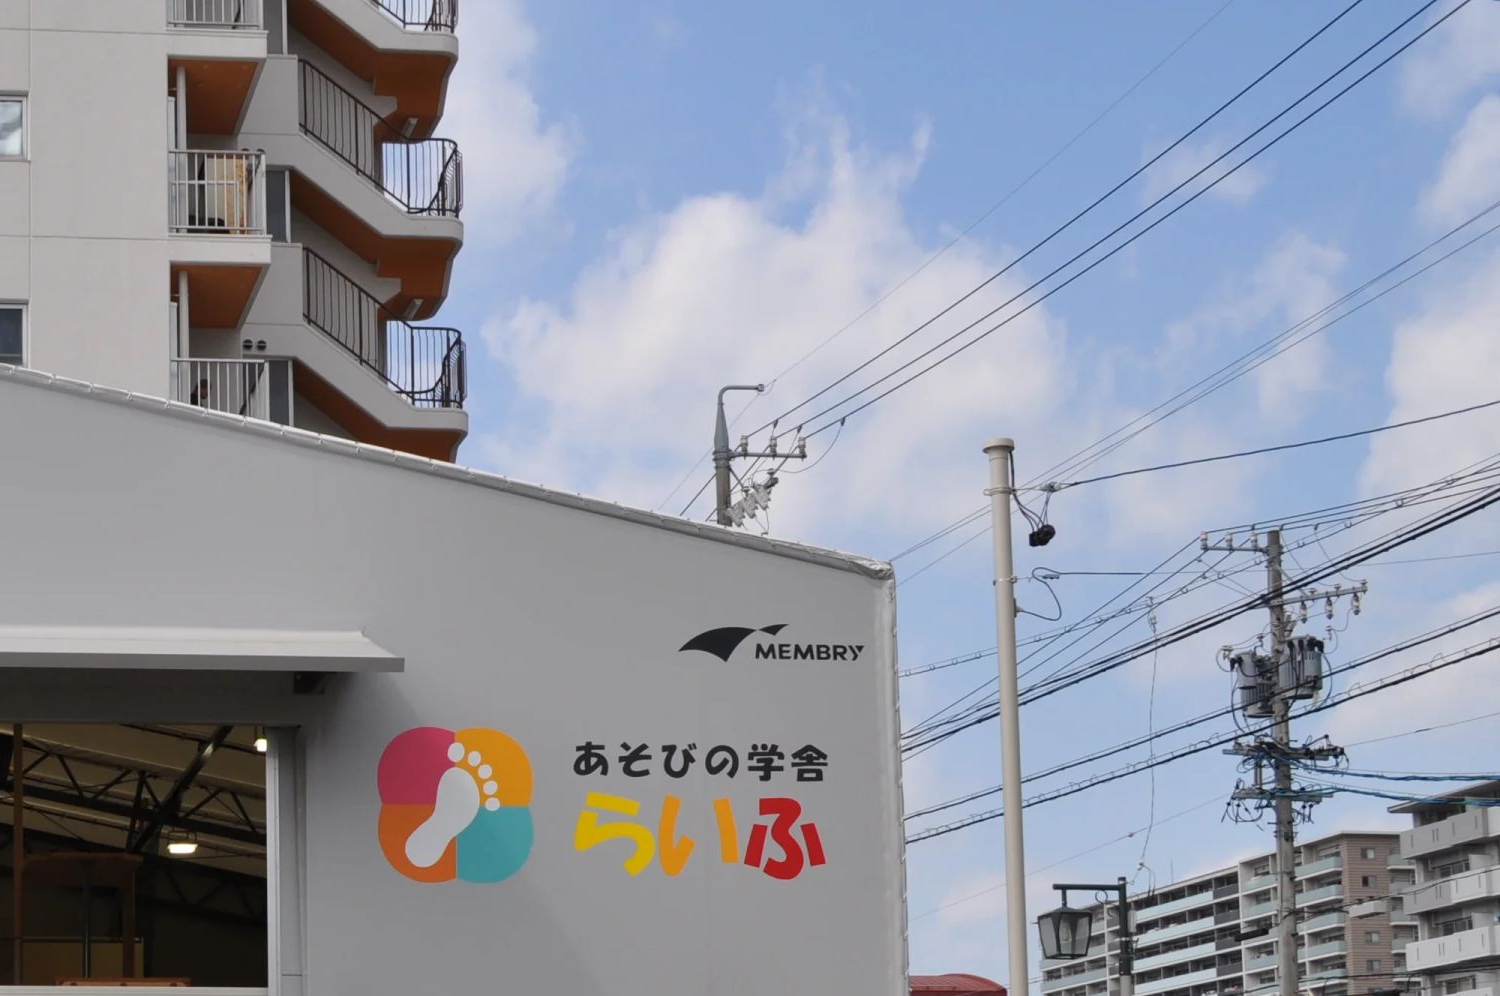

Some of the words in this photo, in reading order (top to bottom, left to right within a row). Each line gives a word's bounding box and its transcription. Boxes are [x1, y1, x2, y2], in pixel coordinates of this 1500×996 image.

[754, 643, 865, 662] MEMBRY
[572, 740, 829, 782] あそびの学舎
[573, 791, 827, 880] らいふ
